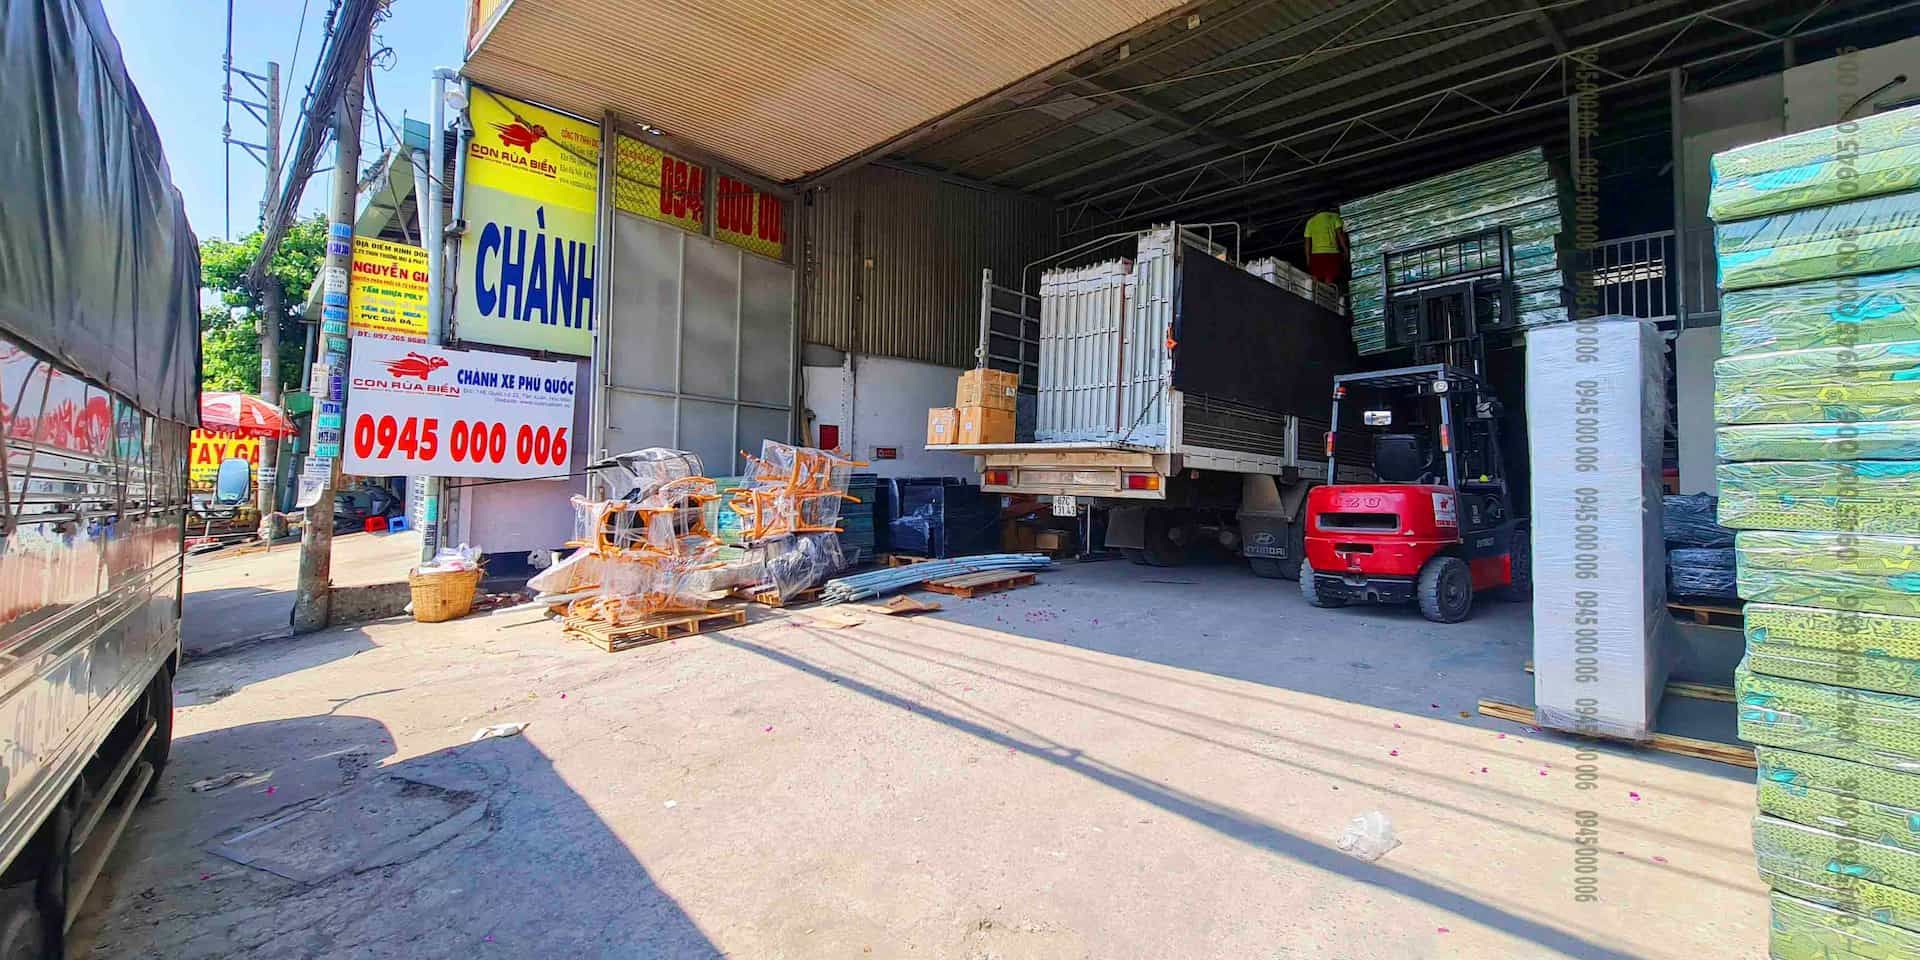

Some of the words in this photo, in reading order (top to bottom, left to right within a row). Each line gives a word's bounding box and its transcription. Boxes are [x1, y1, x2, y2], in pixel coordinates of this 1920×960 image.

[471, 143, 498, 158] CON
[660, 156, 705, 223] 094
[758, 192, 785, 243] 00
[356, 240, 368, 249] ĐỊA
[394, 247, 412, 256] KINH
[353, 262, 408, 280] NGUYỄN
[475, 205, 595, 331] CHÀNH
[361, 313, 379, 321] PVC
[353, 378, 387, 389] CON
[457, 367, 498, 388] CHÀNH
[502, 374, 515, 389] XE
[544, 375, 574, 395] QUỐC
[354, 413, 438, 461] 0945
[450, 420, 507, 464] 000
[516, 424, 569, 466] 006
